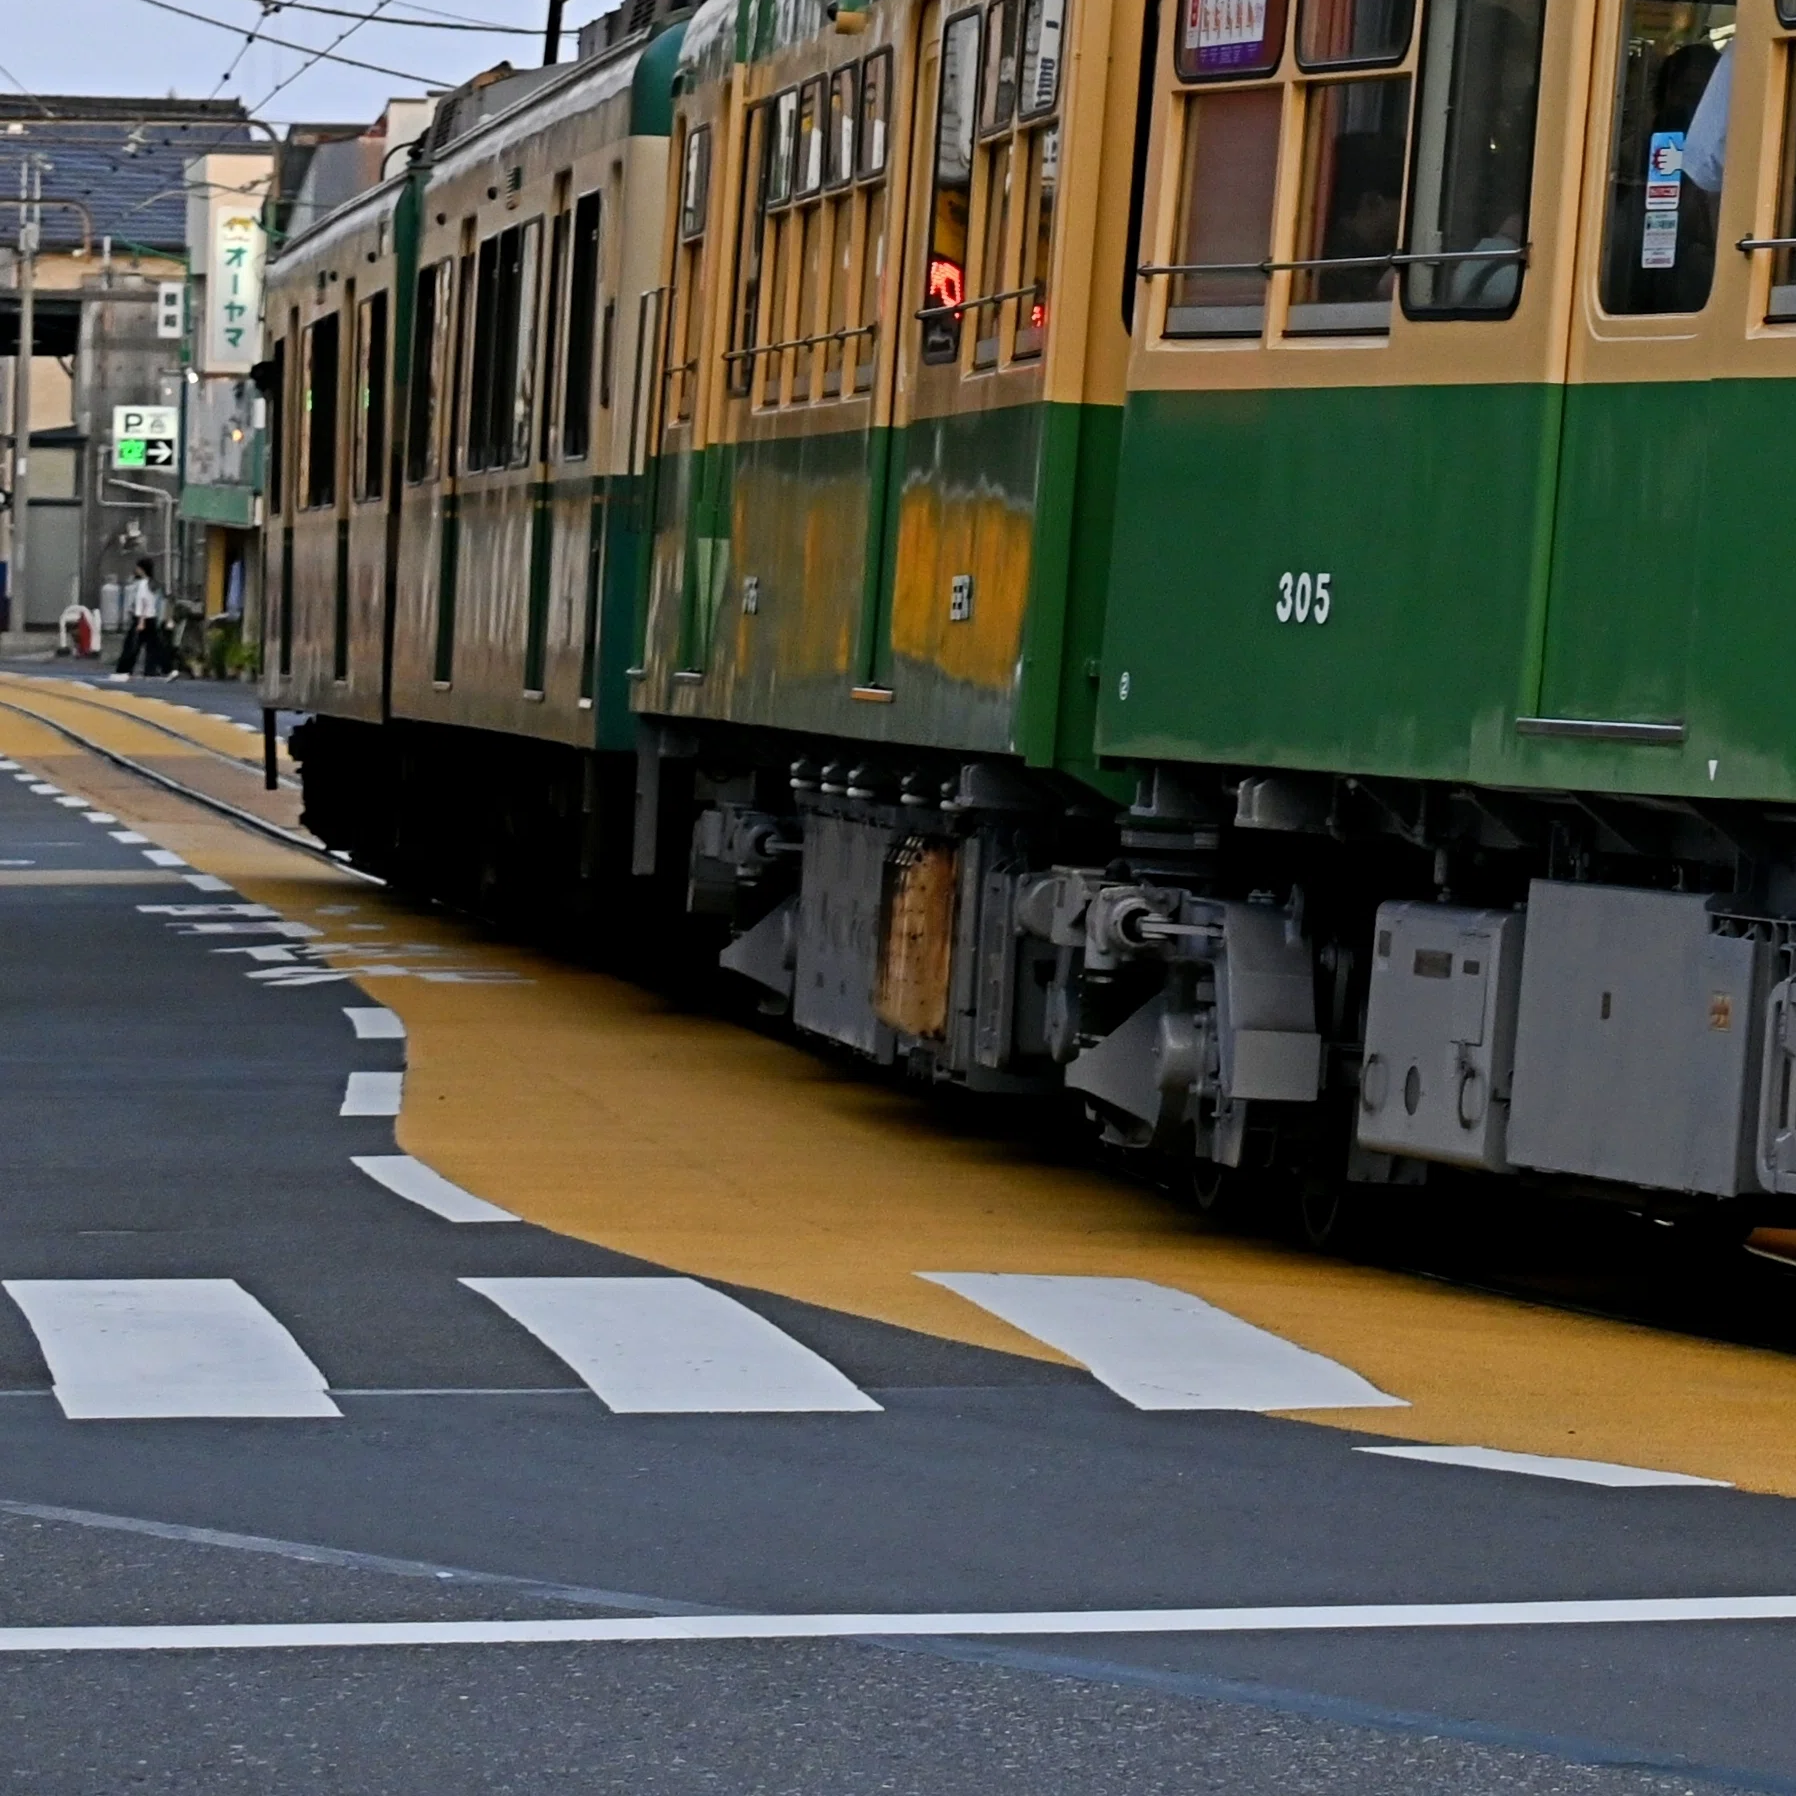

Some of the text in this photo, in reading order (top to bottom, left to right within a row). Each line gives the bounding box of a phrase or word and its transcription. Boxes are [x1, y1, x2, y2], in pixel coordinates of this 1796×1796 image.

[223, 246, 248, 348] オーヤマ
[124, 412, 143, 434] P
[1276, 571, 1330, 624] 305
